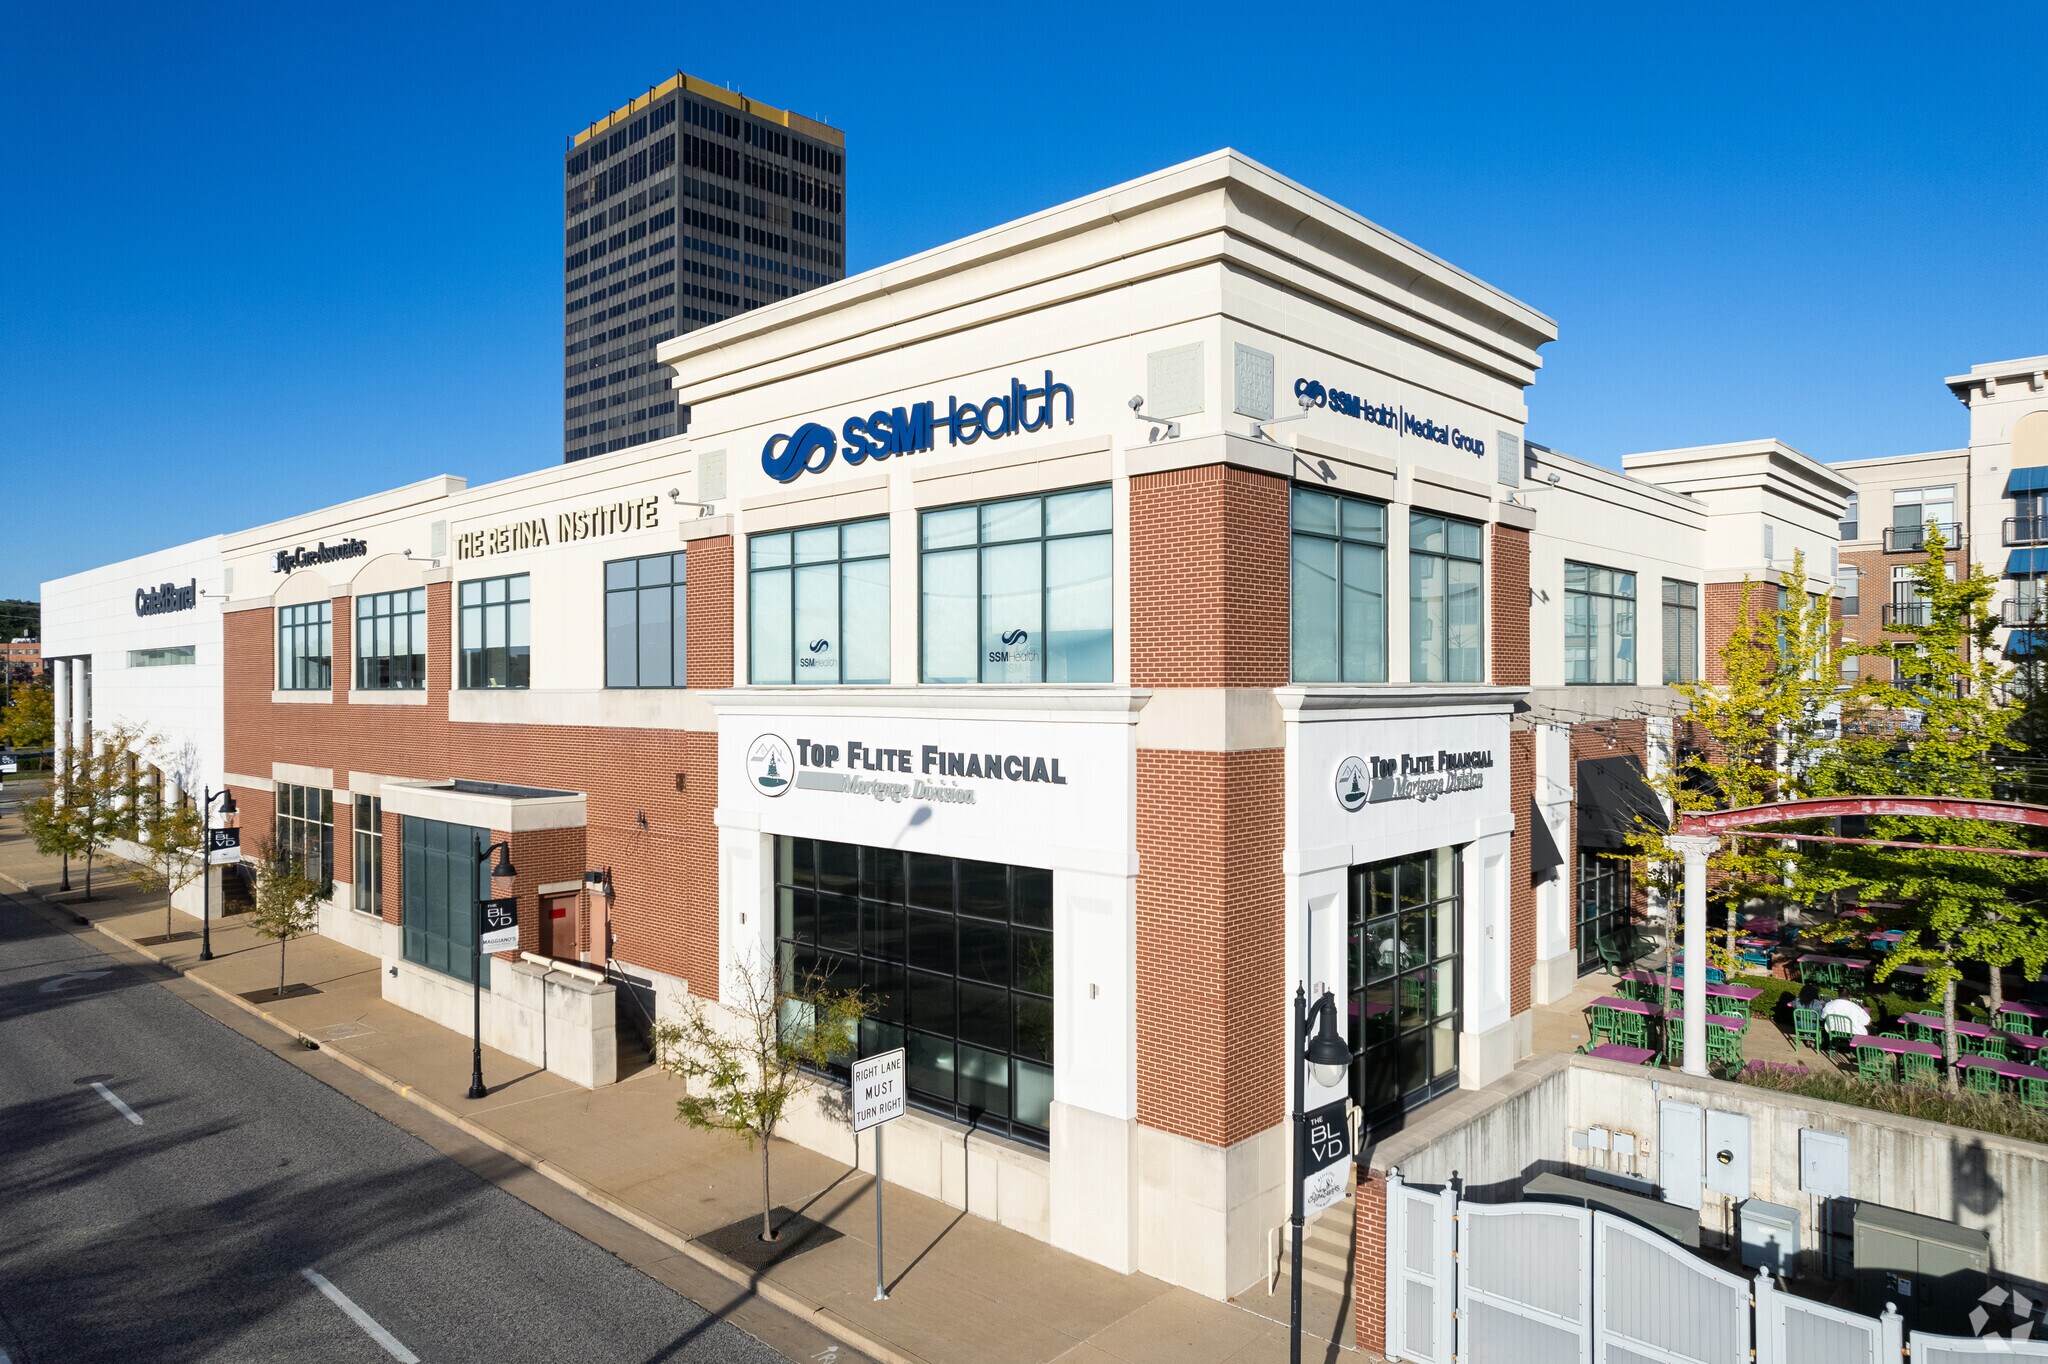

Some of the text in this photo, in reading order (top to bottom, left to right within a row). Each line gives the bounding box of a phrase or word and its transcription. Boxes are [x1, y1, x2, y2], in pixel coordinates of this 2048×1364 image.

[1404, 412, 1448, 446] Medical
[1452, 428, 1485, 459] Group
[454, 495, 659, 560] THE RETINA INSTITUTE
[295, 546, 318, 568] Care
[317, 538, 367, 565] Associates
[796, 738, 1068, 785] TOP FLITE FINANCIAL
[1370, 750, 1494, 779] TOP FLITE FINANCIAL
[842, 774, 976, 805] Mortgage Division
[1393, 769, 1484, 802] Mortgage Division
[855, 1058, 901, 1083] RIGHT LANE
[865, 1080, 893, 1101] MUST
[856, 1097, 902, 1122] TURN RIGHT
[1310, 1115, 1324, 1126] THE
